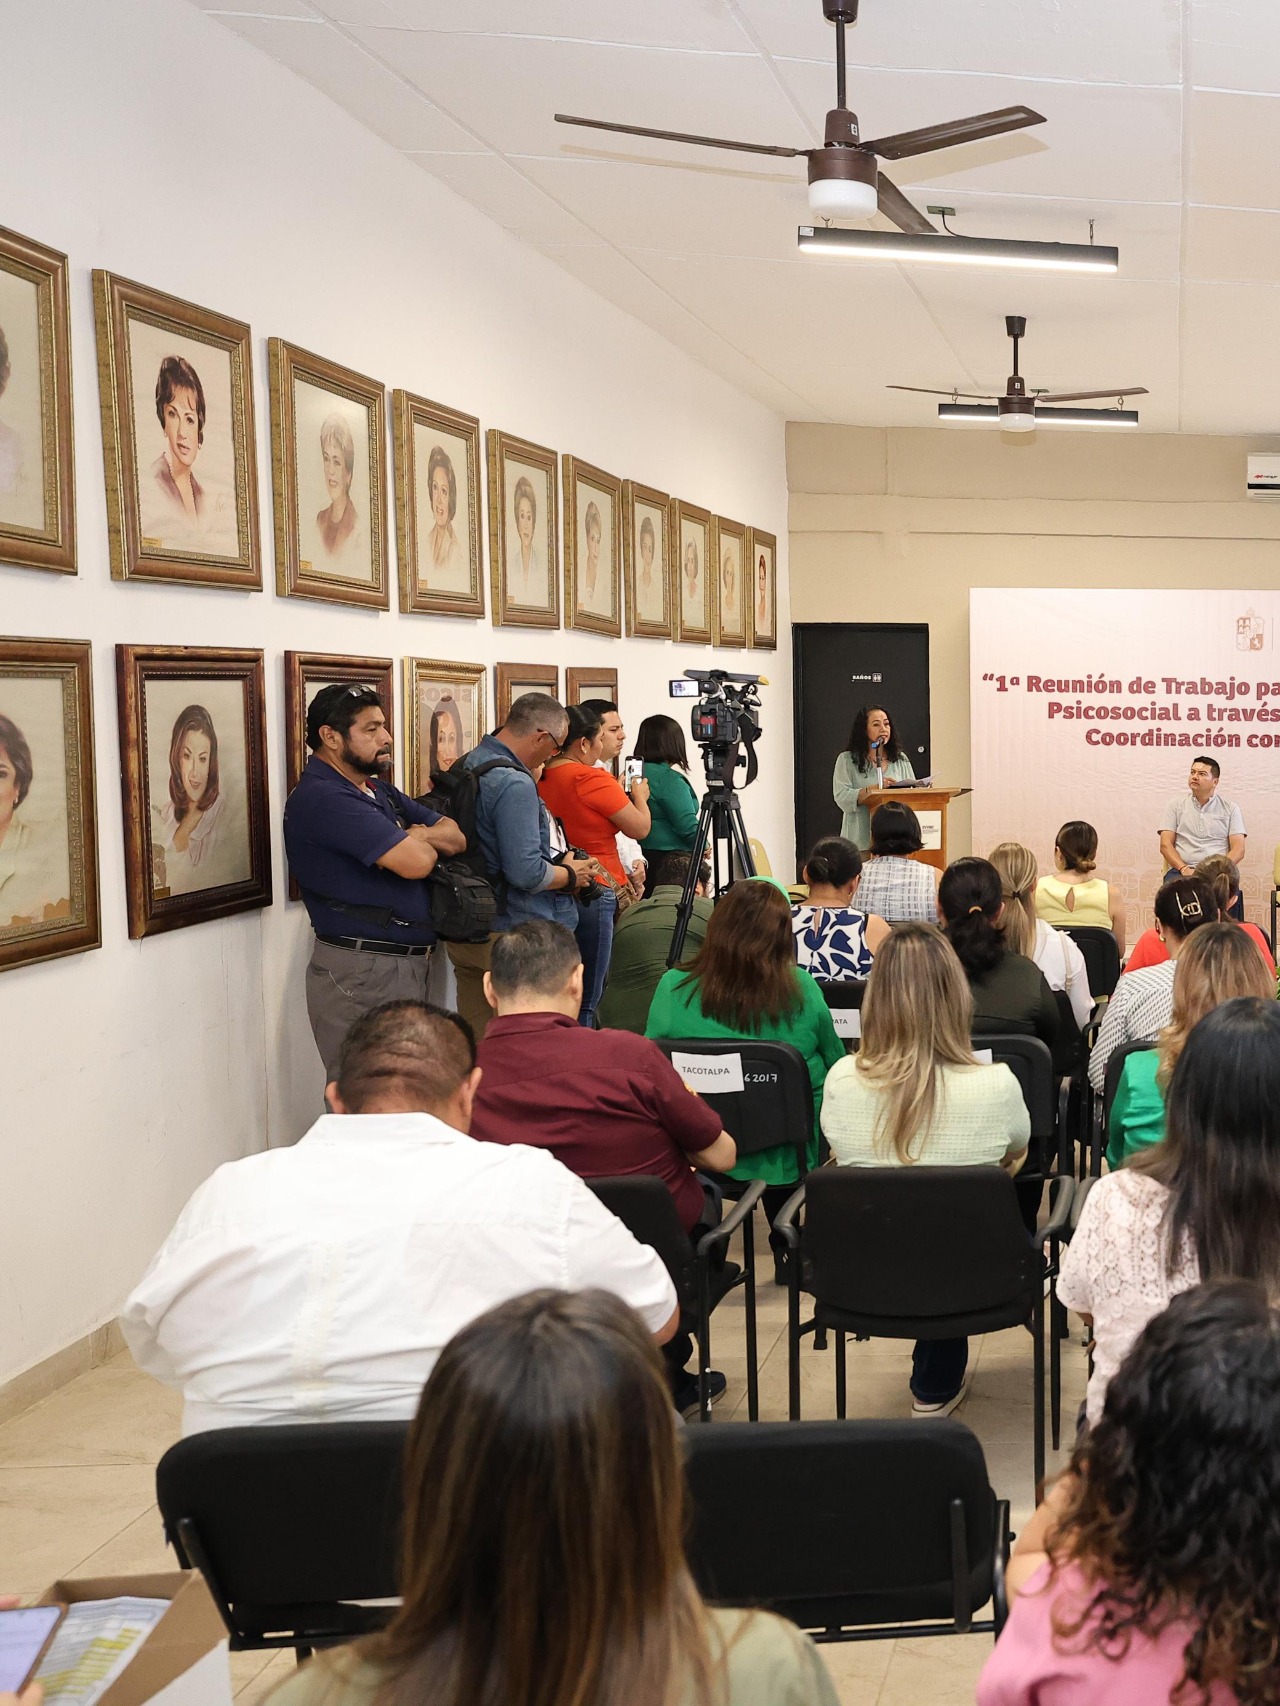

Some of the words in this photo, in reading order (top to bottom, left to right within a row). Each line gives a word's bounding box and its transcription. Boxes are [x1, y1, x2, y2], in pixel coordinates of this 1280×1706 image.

[1026, 672, 1122, 694] Reunión
[1128, 676, 1156, 695] de
[1161, 676, 1251, 701] Trabajo
[1048, 700, 1181, 721] Psicosocial
[1186, 707, 1202, 722] a
[1085, 727, 1241, 748] Coordinación
[681, 1065, 731, 1077] TACOTALPA
